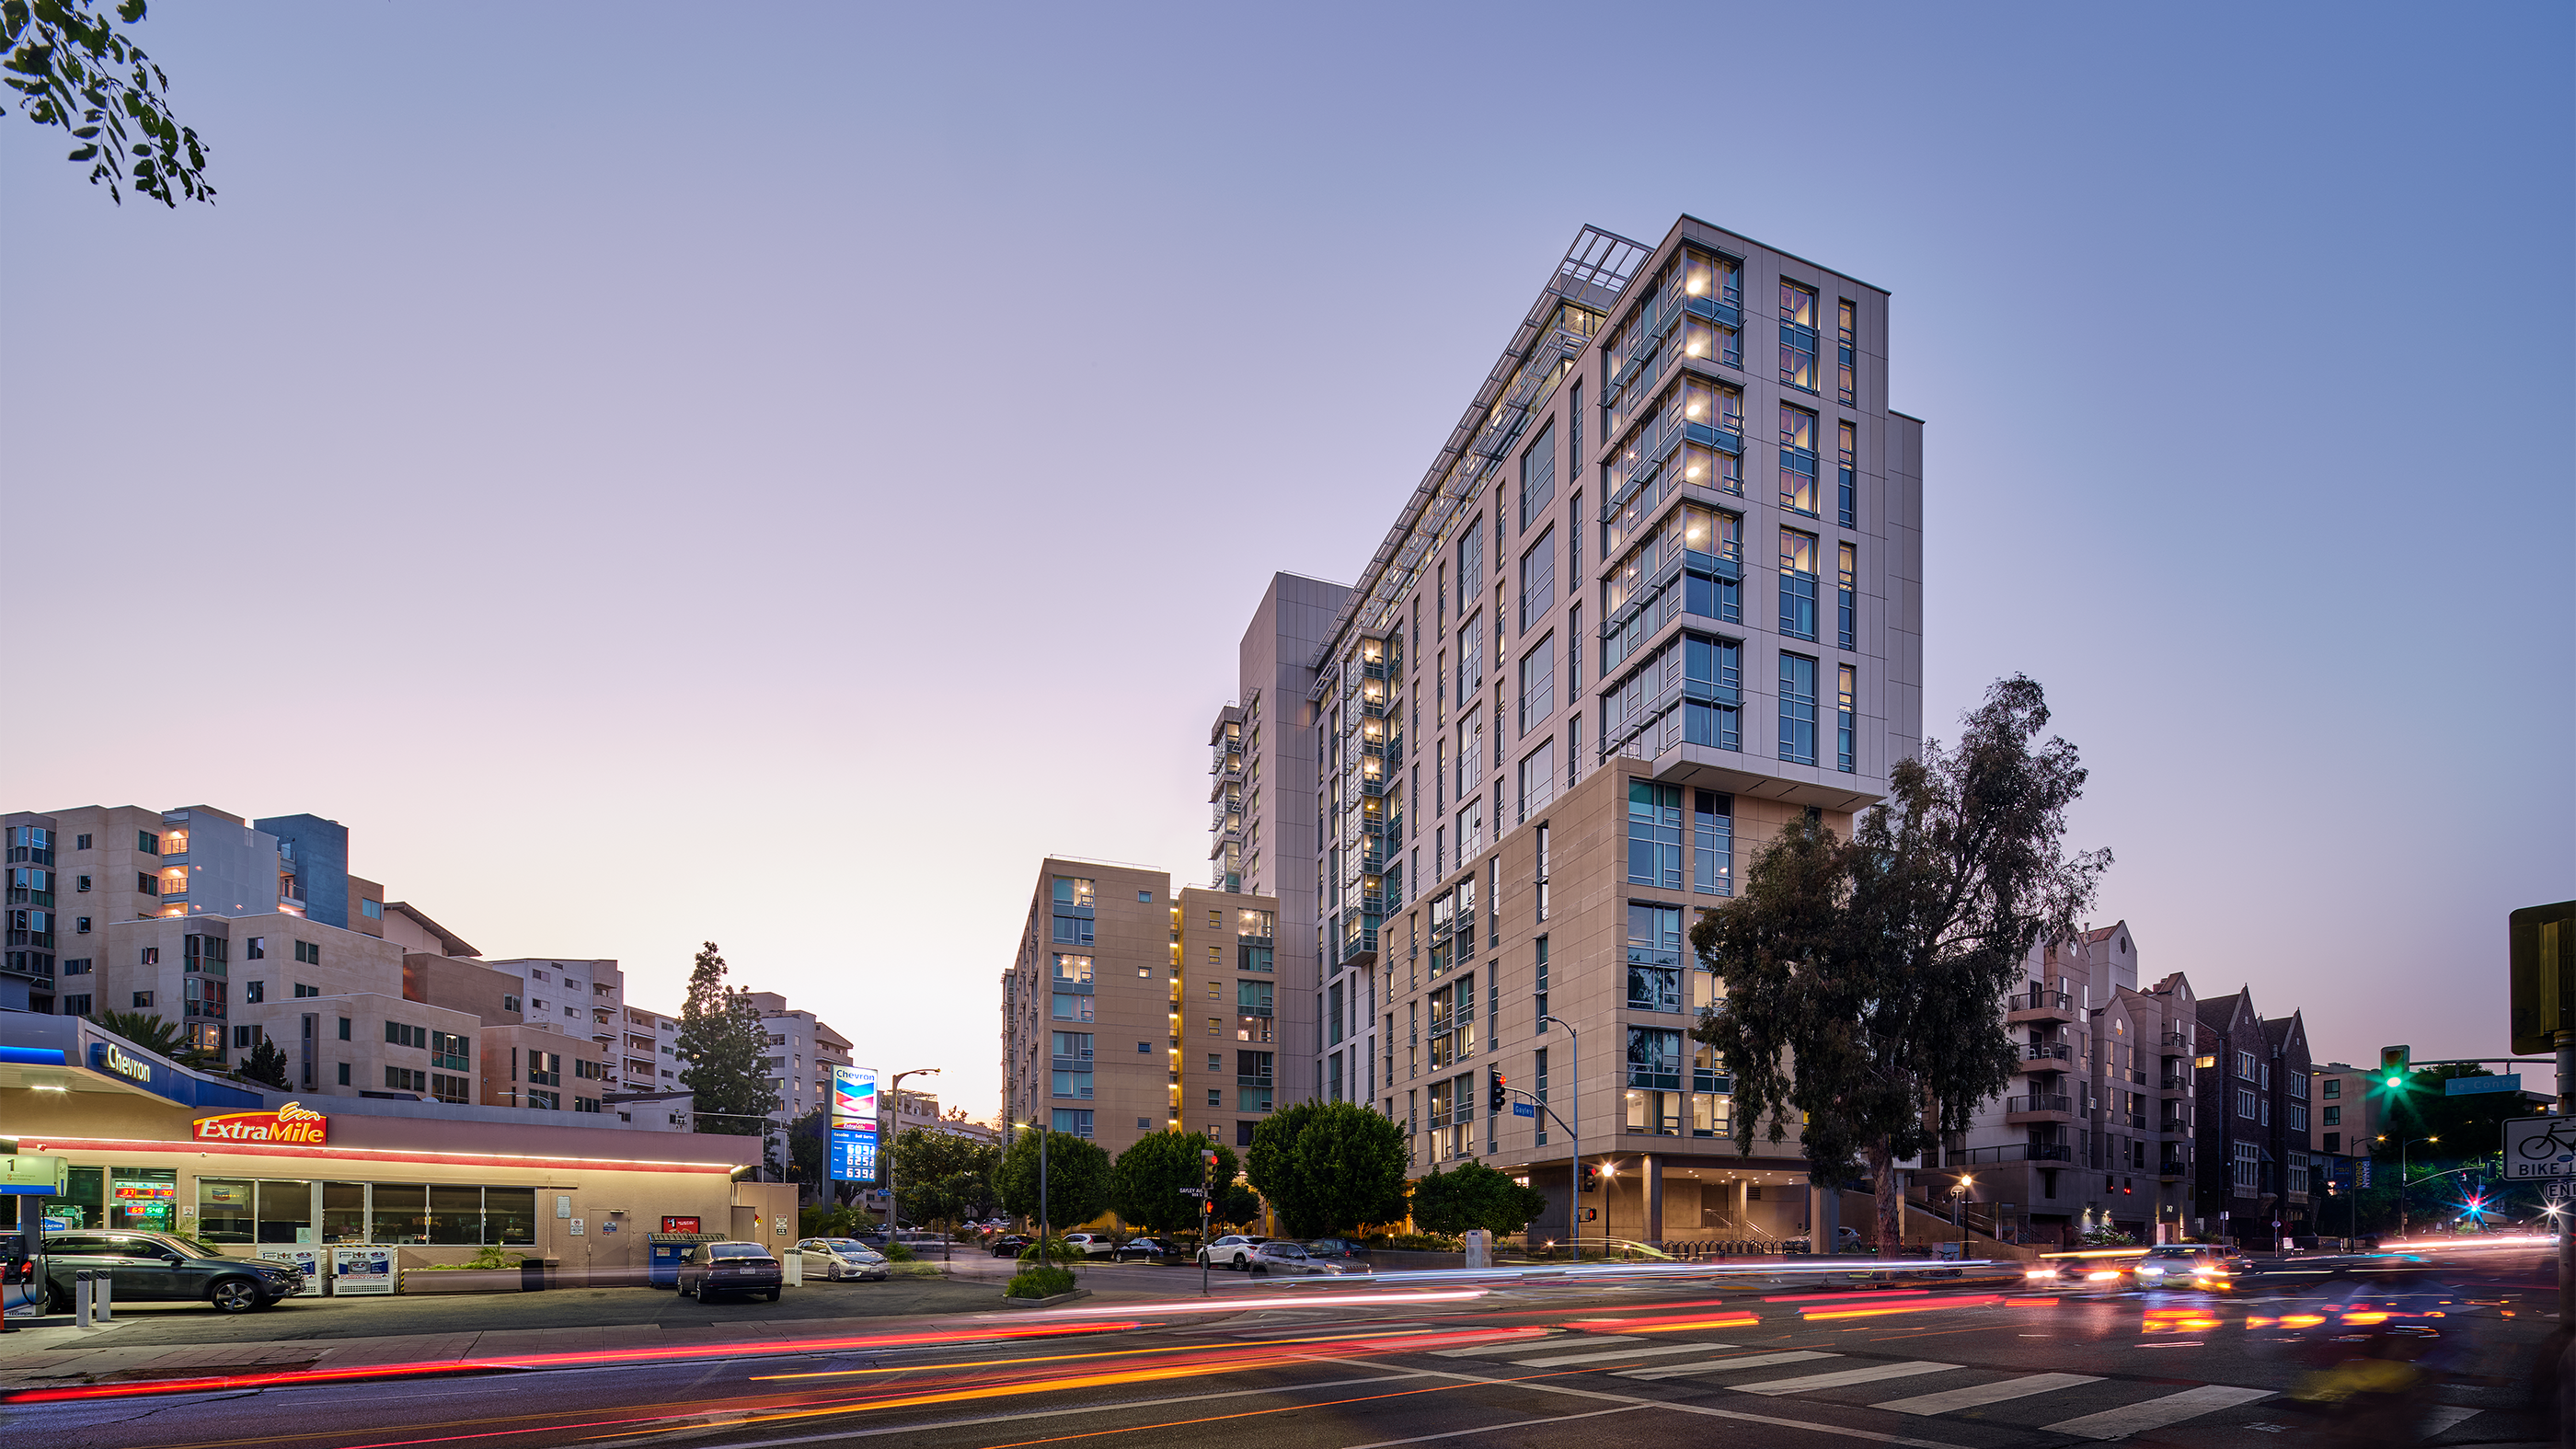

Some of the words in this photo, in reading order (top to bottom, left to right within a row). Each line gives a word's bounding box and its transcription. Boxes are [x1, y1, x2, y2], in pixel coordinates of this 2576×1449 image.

[108, 1043, 150, 1082] Chevron
[836, 1069, 875, 1081] Chevron
[2449, 1083, 2465, 1091] Le
[2474, 1079, 2516, 1089] Conte
[1515, 1106, 1533, 1116] Gayley
[199, 1119, 324, 1143] ExtraMile
[7, 1159, 15, 1171] 1
[2519, 1163, 2559, 1176] BIKE
